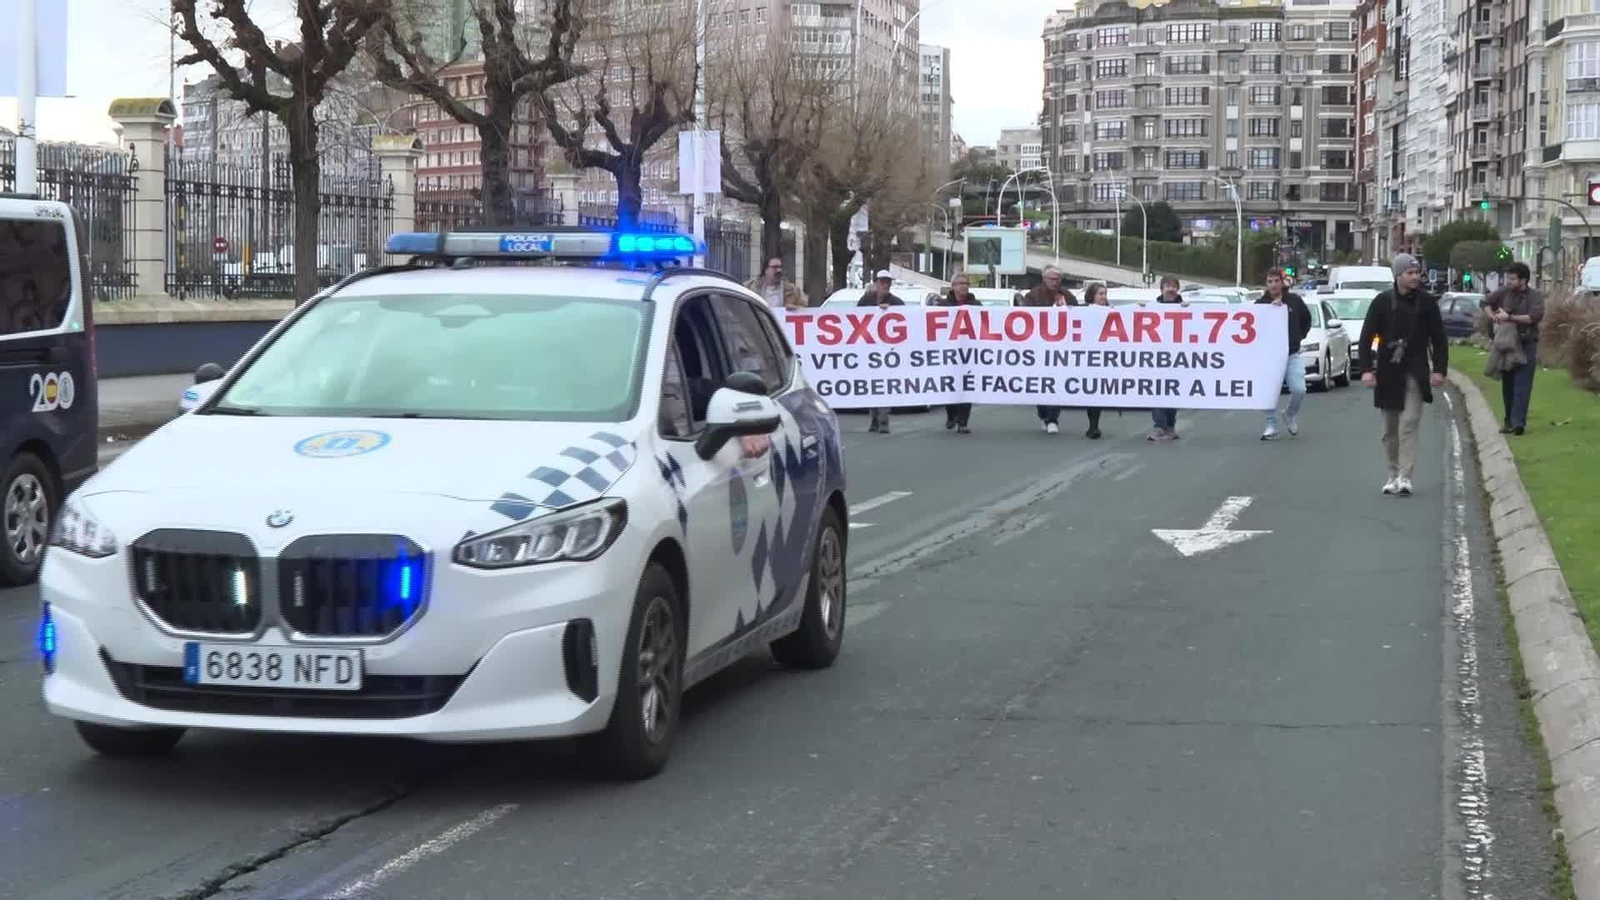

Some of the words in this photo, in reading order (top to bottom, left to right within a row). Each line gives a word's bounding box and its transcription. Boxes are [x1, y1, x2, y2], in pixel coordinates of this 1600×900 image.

[508, 241, 544, 251] LOCAL
[785, 312, 907, 346] TSXG
[926, 309, 1082, 342] FALOU:
[1098, 311, 1257, 344] ART.73
[810, 353, 859, 370] VTC
[868, 348, 901, 369] SÓ
[910, 348, 1036, 368] SERVICIOS
[1044, 350, 1225, 369] INTERURBANS
[816, 376, 956, 397] GOBERNAR
[962, 371, 975, 392] É
[981, 375, 1056, 394] FACER
[1064, 377, 1181, 397] CUMPRIR
[1188, 380, 1206, 397] A
[1214, 380, 1253, 397] LEI
[206, 651, 283, 681] 6838
[293, 654, 353, 684] NFD
